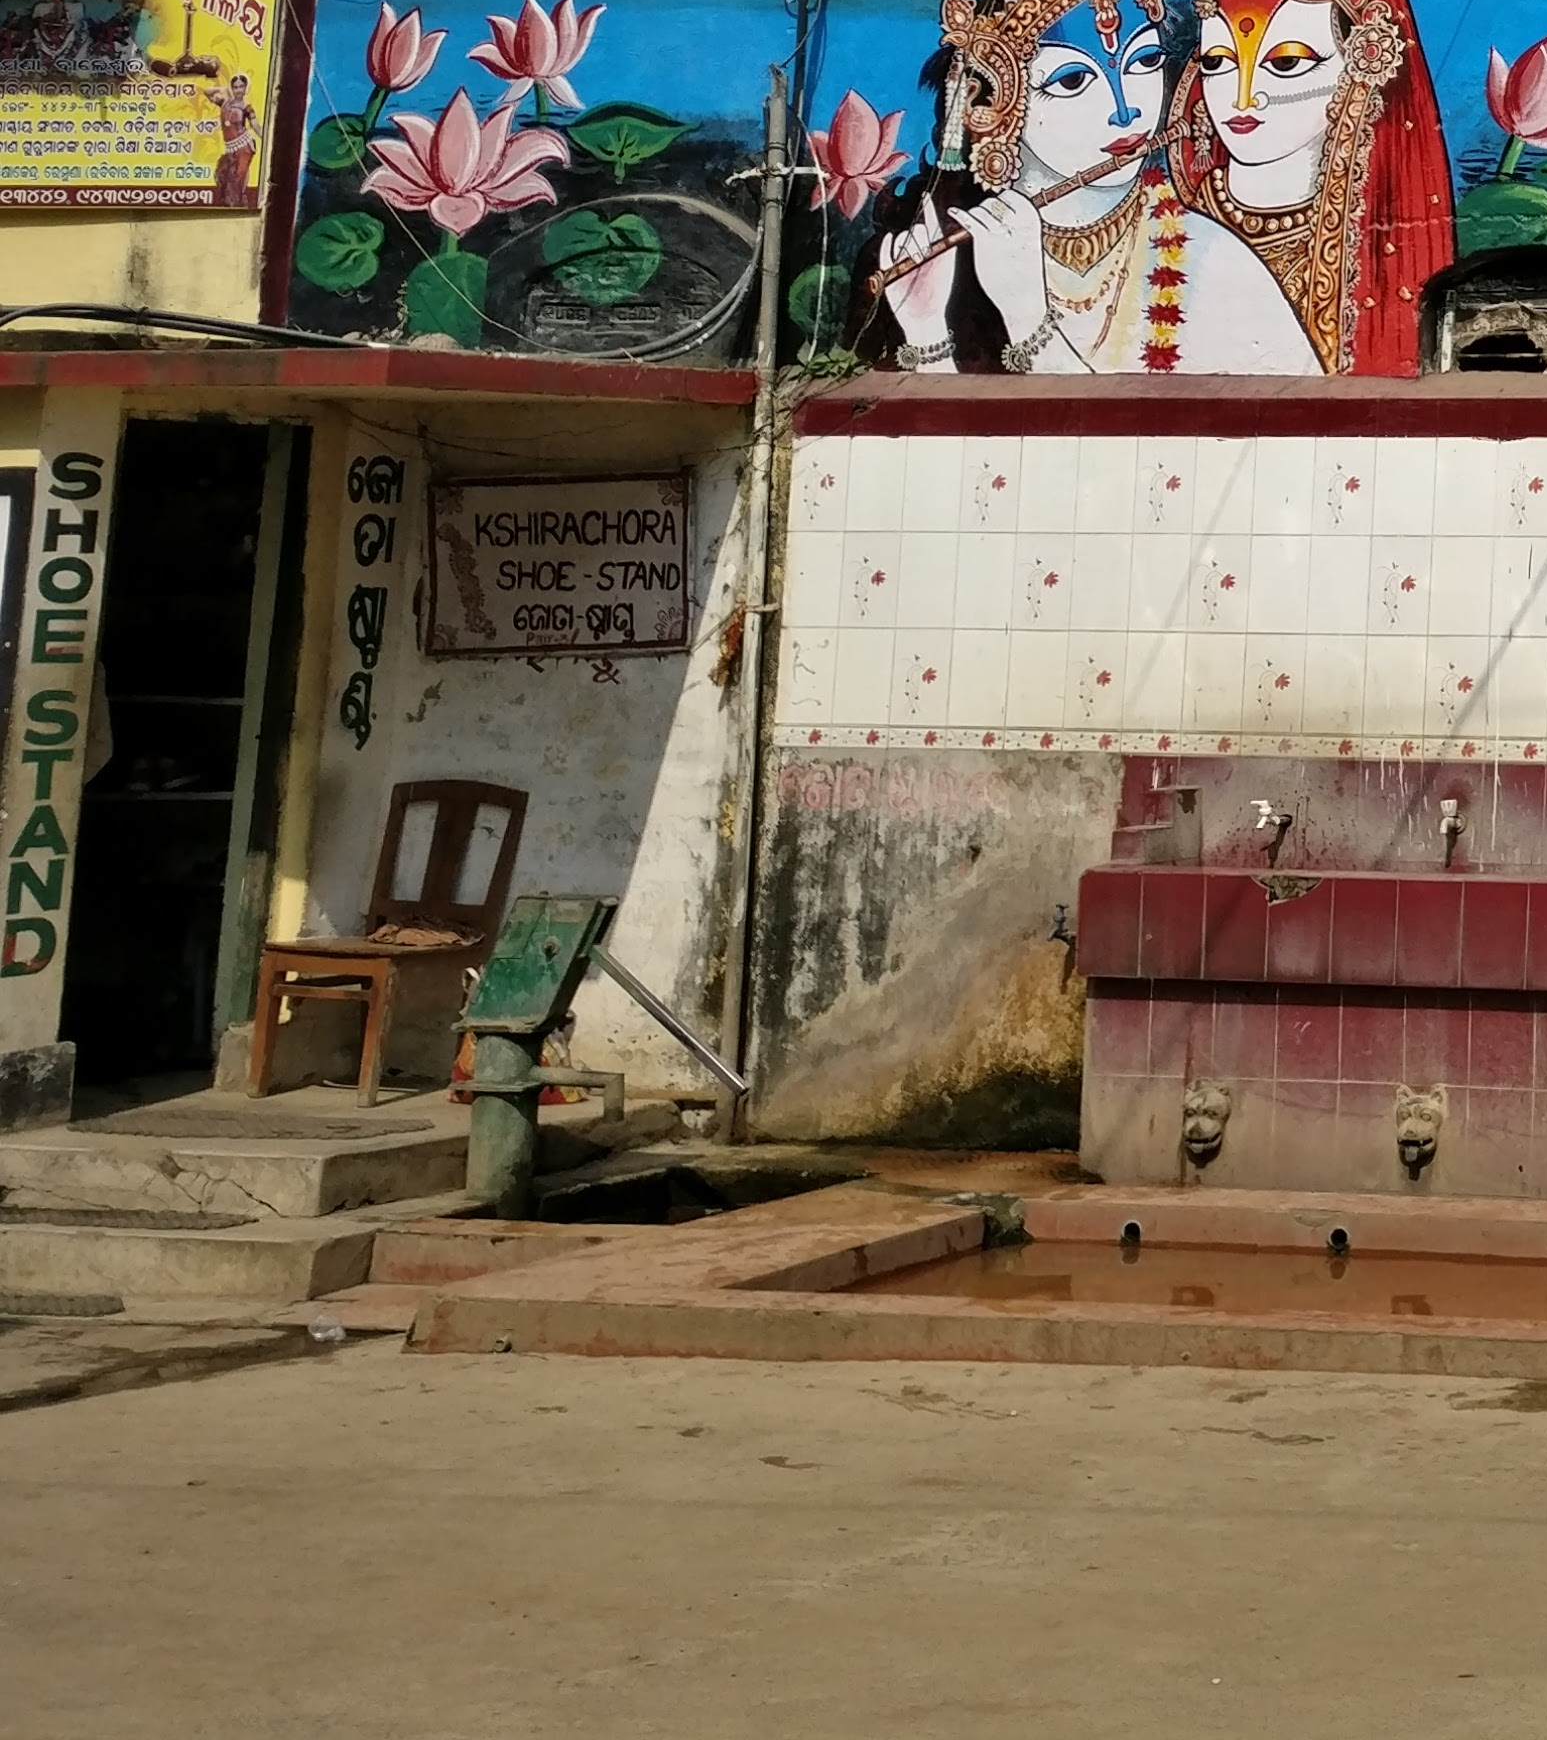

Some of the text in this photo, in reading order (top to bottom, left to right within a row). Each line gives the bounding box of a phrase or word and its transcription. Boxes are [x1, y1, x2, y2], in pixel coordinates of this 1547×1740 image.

[31, 452, 104, 664] SHOE
[475, 510, 676, 547] KSHIRACHORA
[496, 561, 577, 591] SHOE
[597, 561, 681, 591] STAND
[0, 690, 80, 977] STAND
